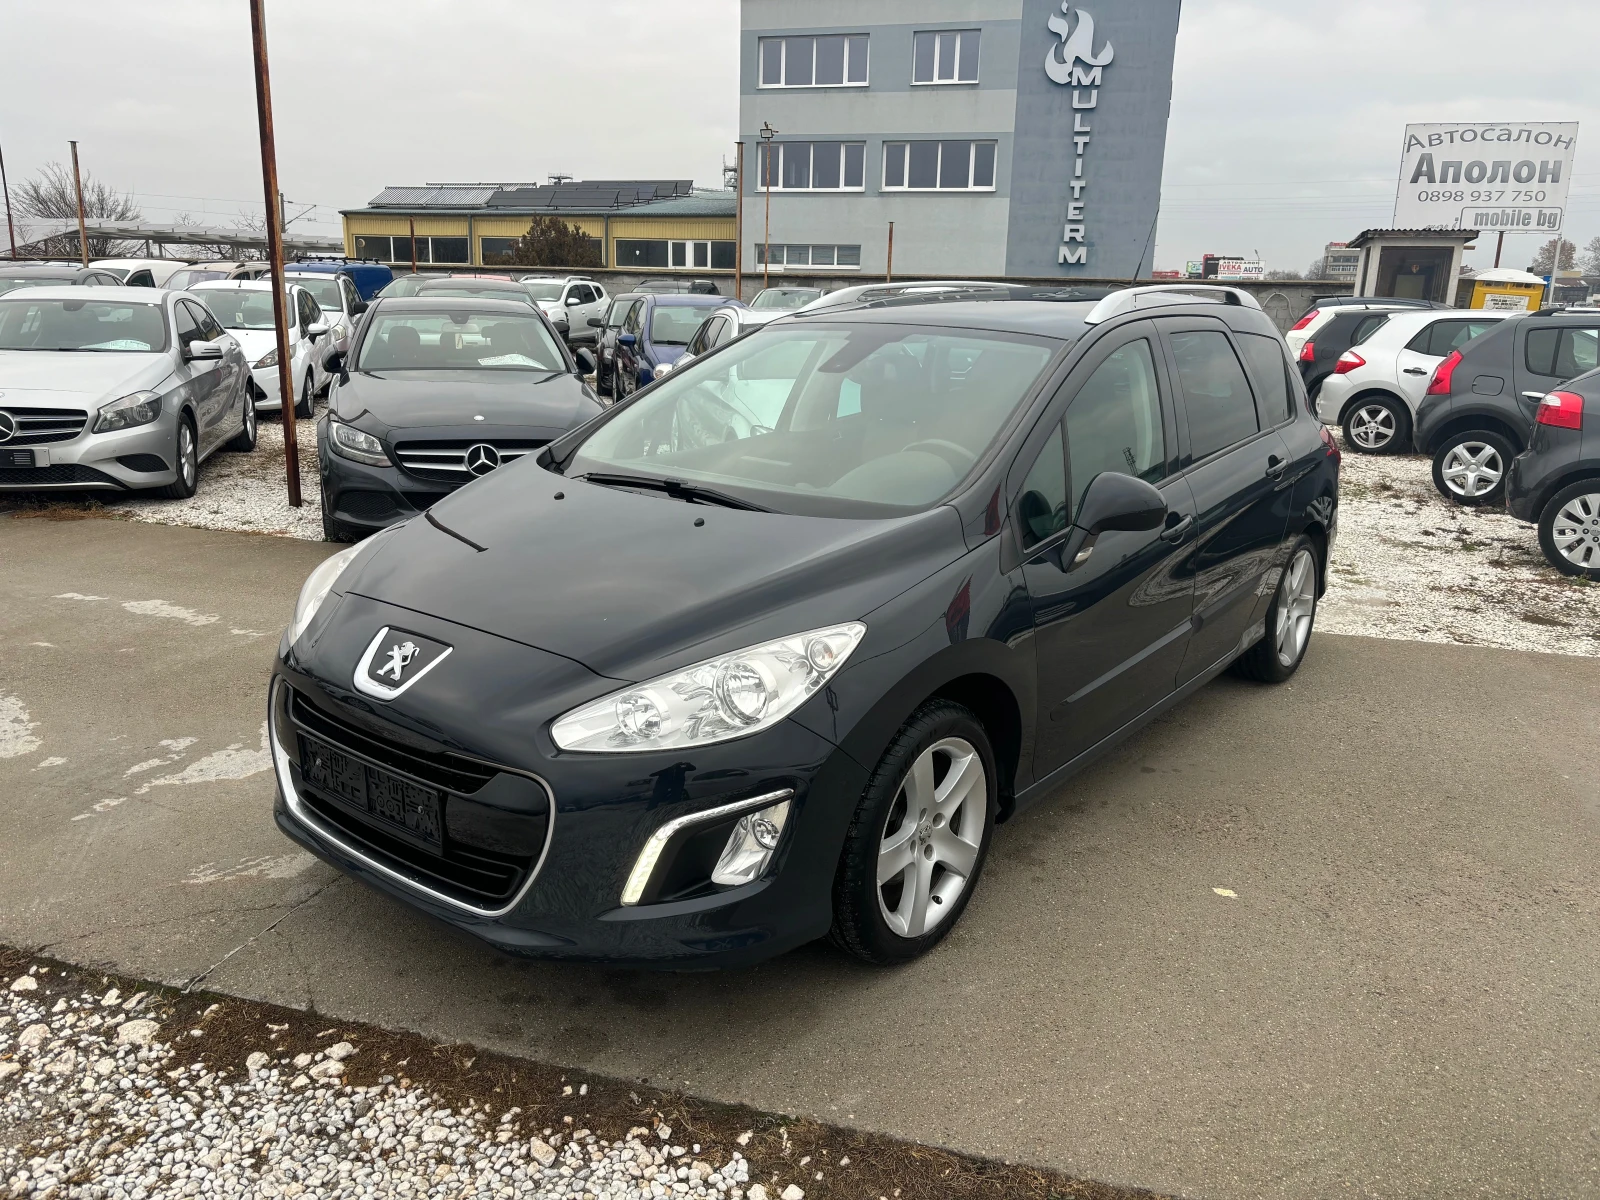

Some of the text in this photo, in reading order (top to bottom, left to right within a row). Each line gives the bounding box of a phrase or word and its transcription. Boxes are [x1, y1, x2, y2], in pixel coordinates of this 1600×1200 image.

[1406, 127, 1574, 153] Автосалон
[1058, 66, 1102, 264] MULTITERM
[1409, 152, 1562, 184] Аполон
[1417, 190, 1547, 202] 0898 937 750
[1473, 209, 1559, 229] mobile bg
